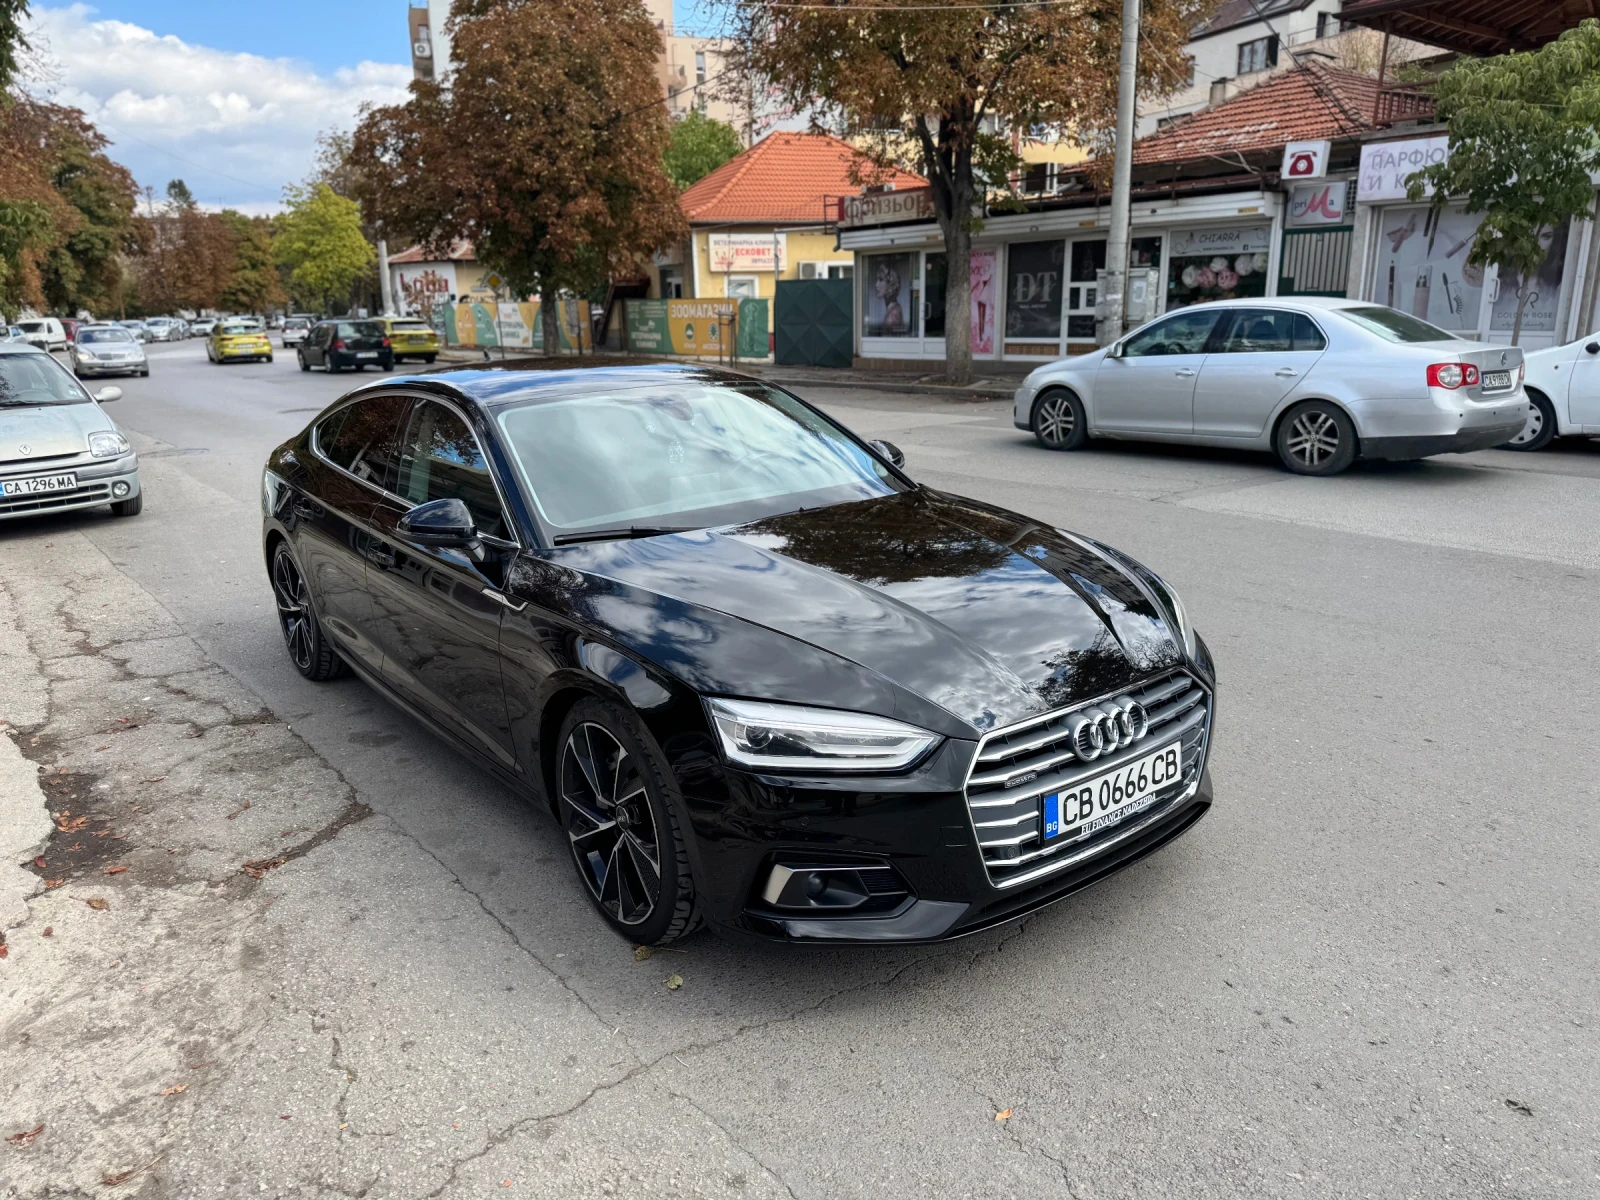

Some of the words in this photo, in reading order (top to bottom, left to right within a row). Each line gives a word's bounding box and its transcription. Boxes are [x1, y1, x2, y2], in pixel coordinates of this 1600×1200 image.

[1371, 147, 1450, 171] ПАРФЮ
[4, 482, 22, 494] CA
[25, 478, 55, 492] 1296
[56, 476, 75, 488] MA
[1046, 821, 1058, 833] BG
[1063, 786, 1094, 825] CB
[1099, 761, 1148, 811] 0666
[1151, 748, 1178, 785] CB
[1092, 811, 1123, 831] FINANCE
